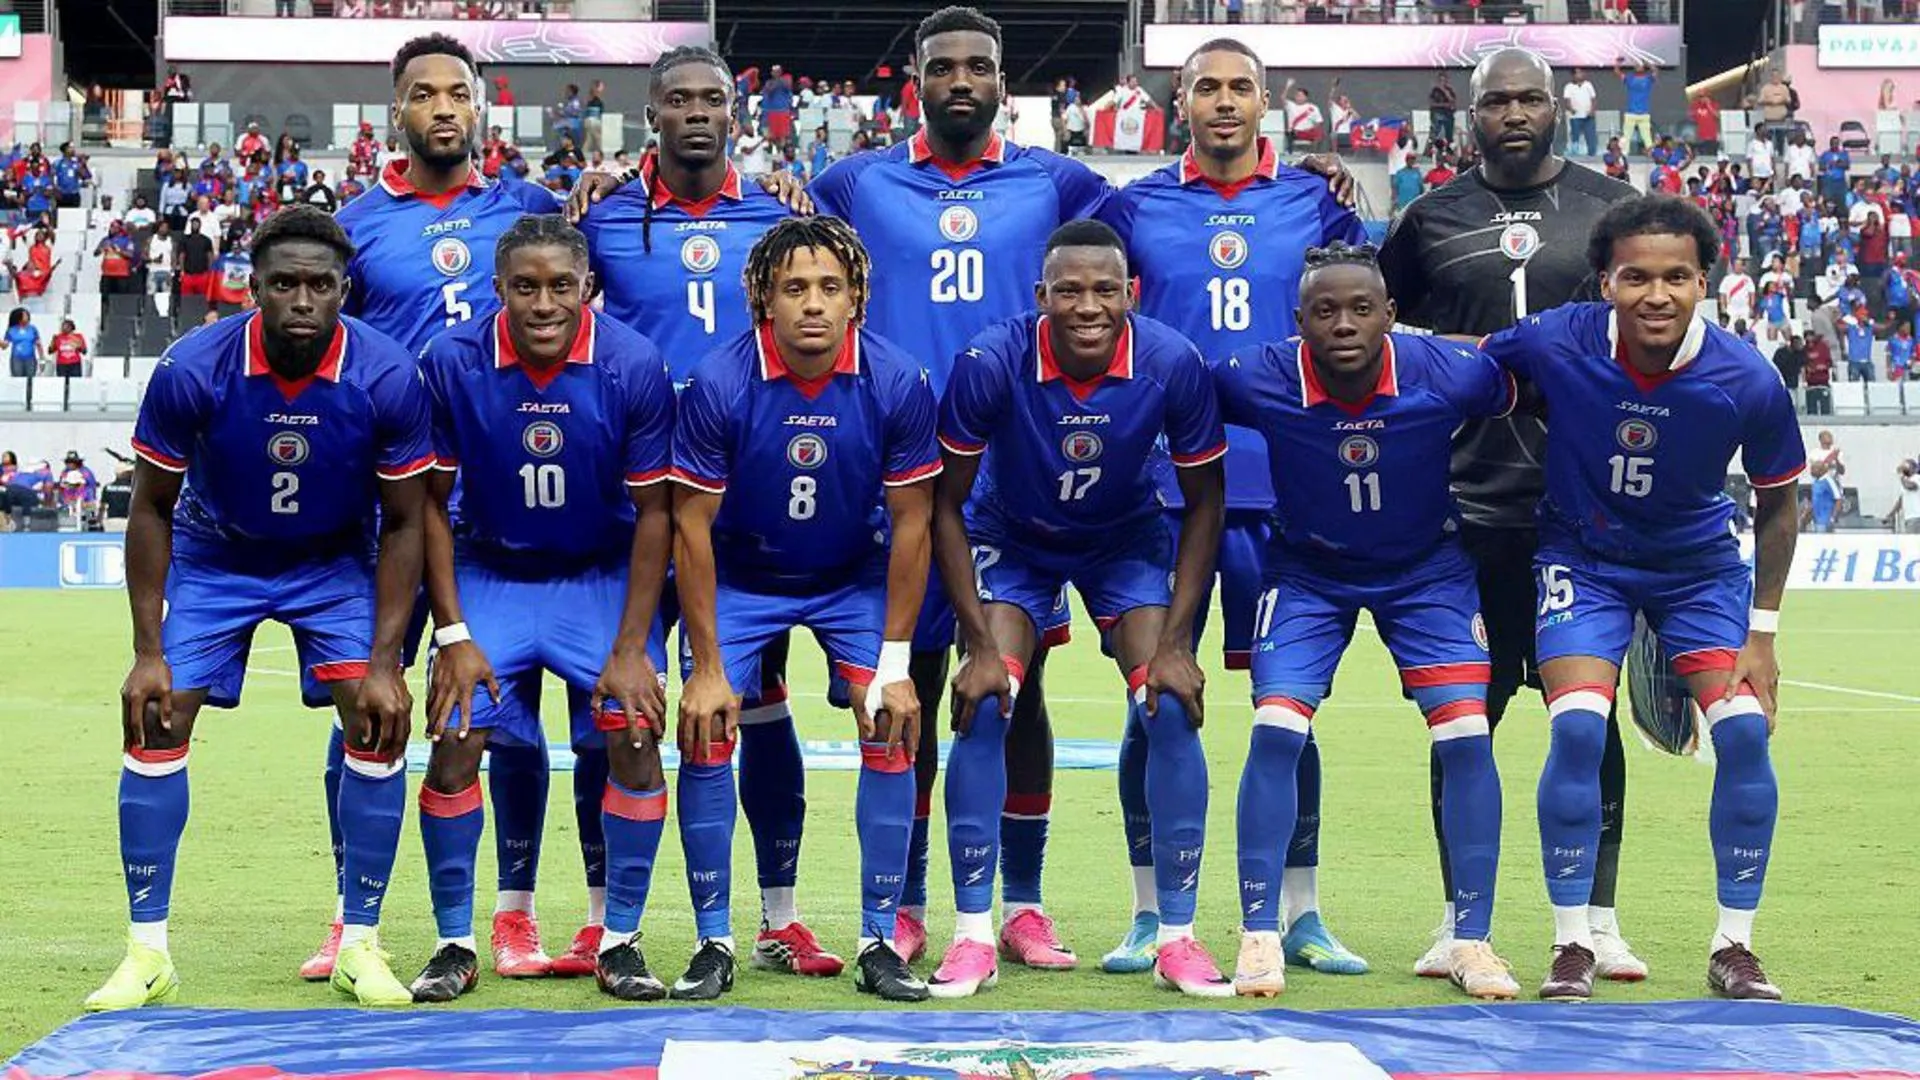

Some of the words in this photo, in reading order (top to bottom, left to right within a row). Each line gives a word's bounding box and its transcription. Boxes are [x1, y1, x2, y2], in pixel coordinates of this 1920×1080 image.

[937, 190, 984, 201] SAETA
[1205, 214, 1256, 227] SAETA
[1490, 211, 1541, 222] SAETA
[423, 218, 471, 236] SAETA
[674, 221, 727, 233] SAETA
[931, 248, 984, 303] 20
[1510, 266, 1527, 319] 1
[442, 282, 471, 328] 5
[688, 280, 715, 334] 4
[1206, 276, 1250, 331] 18
[517, 402, 570, 414] SAETA
[1616, 400, 1670, 417] SAETA
[264, 413, 319, 425] SAETA
[783, 415, 837, 427] SAETA
[1057, 413, 1110, 425] SAETA
[1332, 419, 1385, 430] SAETA
[1058, 467, 1101, 501] 17
[1608, 455, 1654, 498] 15
[271, 471, 300, 513] 2
[518, 463, 565, 509] 10
[1344, 472, 1381, 513] 11
[789, 475, 816, 520] 8
[1811, 548, 1859, 582] #1
[129, 864, 157, 876] FHF
[875, 874, 902, 885] FHF
